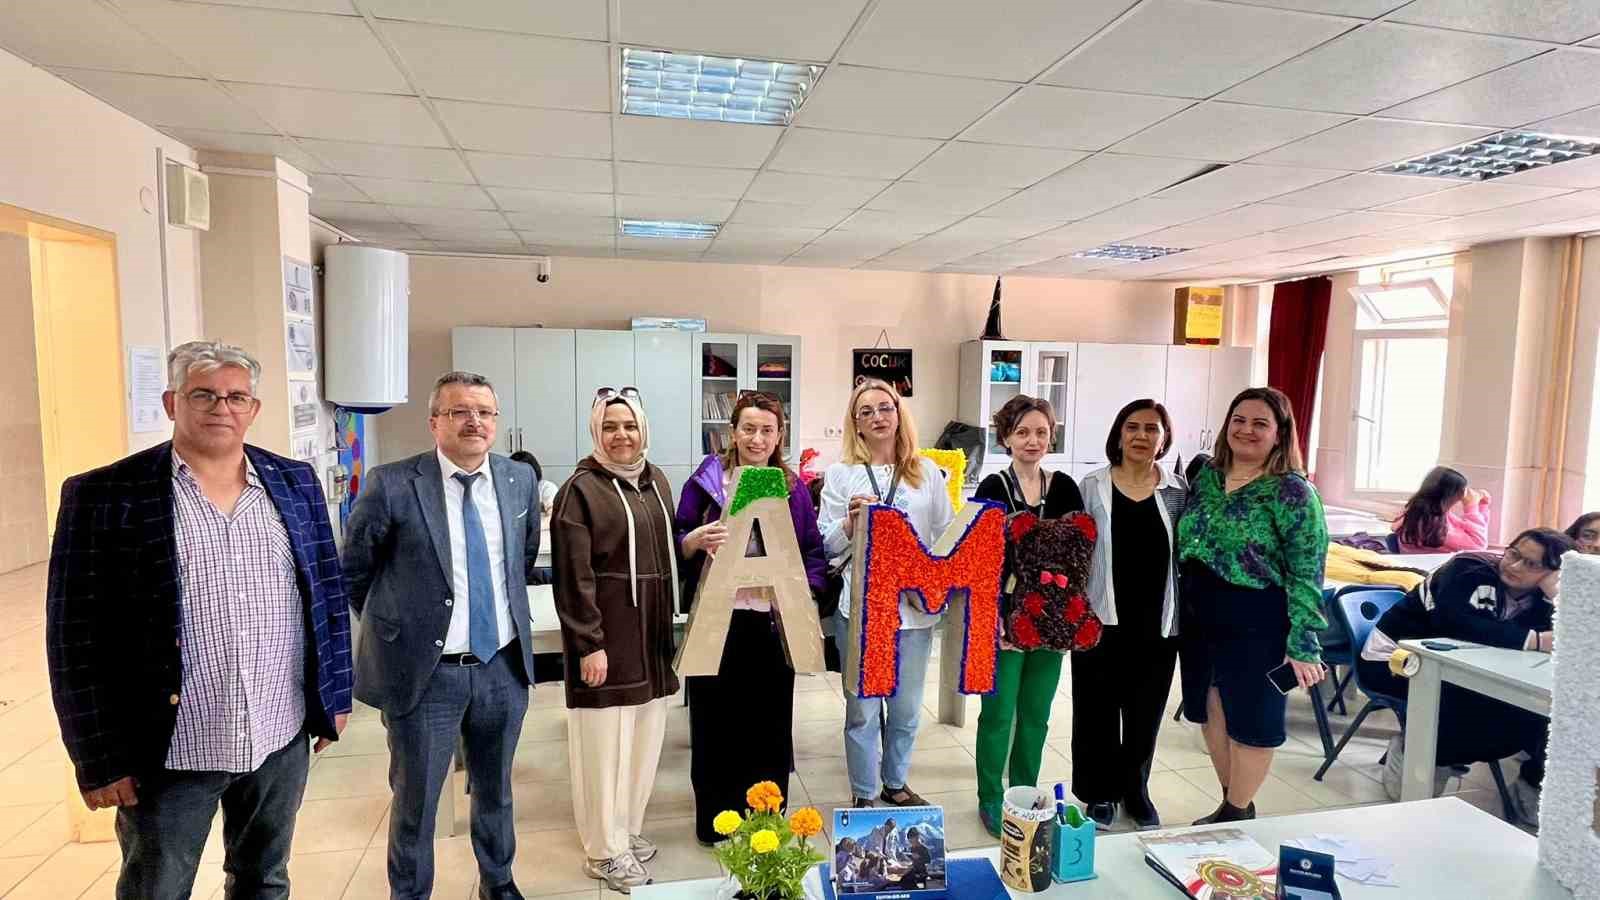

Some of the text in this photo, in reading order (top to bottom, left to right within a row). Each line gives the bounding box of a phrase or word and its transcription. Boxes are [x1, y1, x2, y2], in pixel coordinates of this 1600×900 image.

[675, 465, 827, 677] A
[856, 498, 1009, 699] M
[1067, 838, 1083, 866] 3
